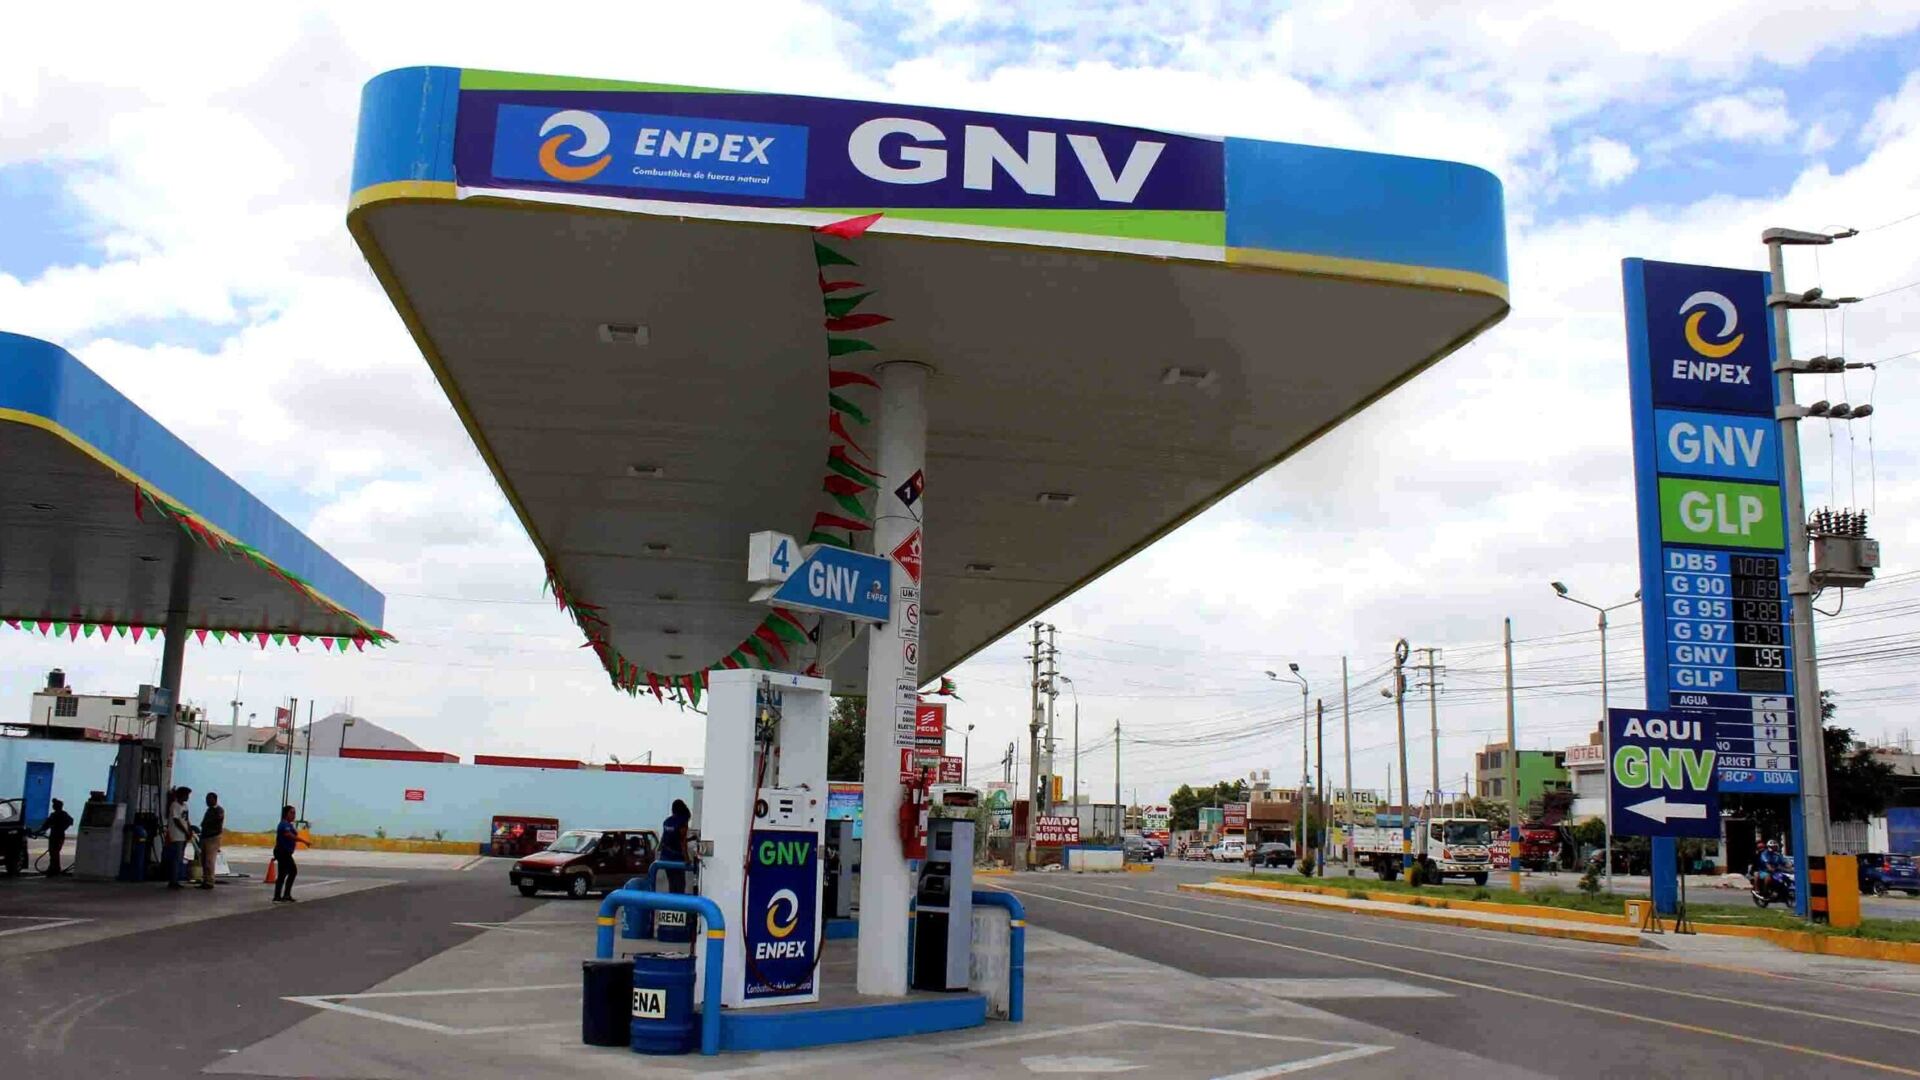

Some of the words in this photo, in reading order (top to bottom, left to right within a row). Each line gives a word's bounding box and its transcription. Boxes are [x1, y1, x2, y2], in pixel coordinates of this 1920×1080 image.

[634, 128, 776, 165] ENPEX
[847, 117, 1166, 202] GNV
[632, 166, 691, 178] Combustibles
[694, 170, 705, 179] de
[707, 172, 736, 182] fuerza
[737, 175, 770, 185] natural
[1672, 359, 1752, 385] ENPEX
[1668, 422, 1765, 467] GNV
[1679, 491, 1764, 536] GLP
[772, 539, 790, 573] 4
[1670, 552, 1718, 571] DB5
[808, 560, 860, 603] GNV
[1671, 576, 1689, 592] G
[1696, 577, 1725, 594] 90
[866, 591, 888, 603] ENPEX
[1673, 599, 1690, 616] G
[1698, 600, 1727, 618] 95
[1674, 622, 1692, 639] G
[1699, 624, 1727, 641] 97
[1675, 645, 1728, 664] GNV
[1755, 649, 1782, 668] 1.95
[1676, 669, 1724, 687] GLP
[1680, 695, 1709, 705] AGUA
[1623, 718, 1702, 740] AQUI
[1613, 744, 1717, 791] GNV
[1725, 770, 1748, 782] BCP
[1763, 772, 1794, 784] BBVA
[759, 840, 810, 865] GNV
[657, 912, 685, 923] ARENA
[755, 940, 807, 960] ENPEX
[632, 991, 661, 1014] ENA
